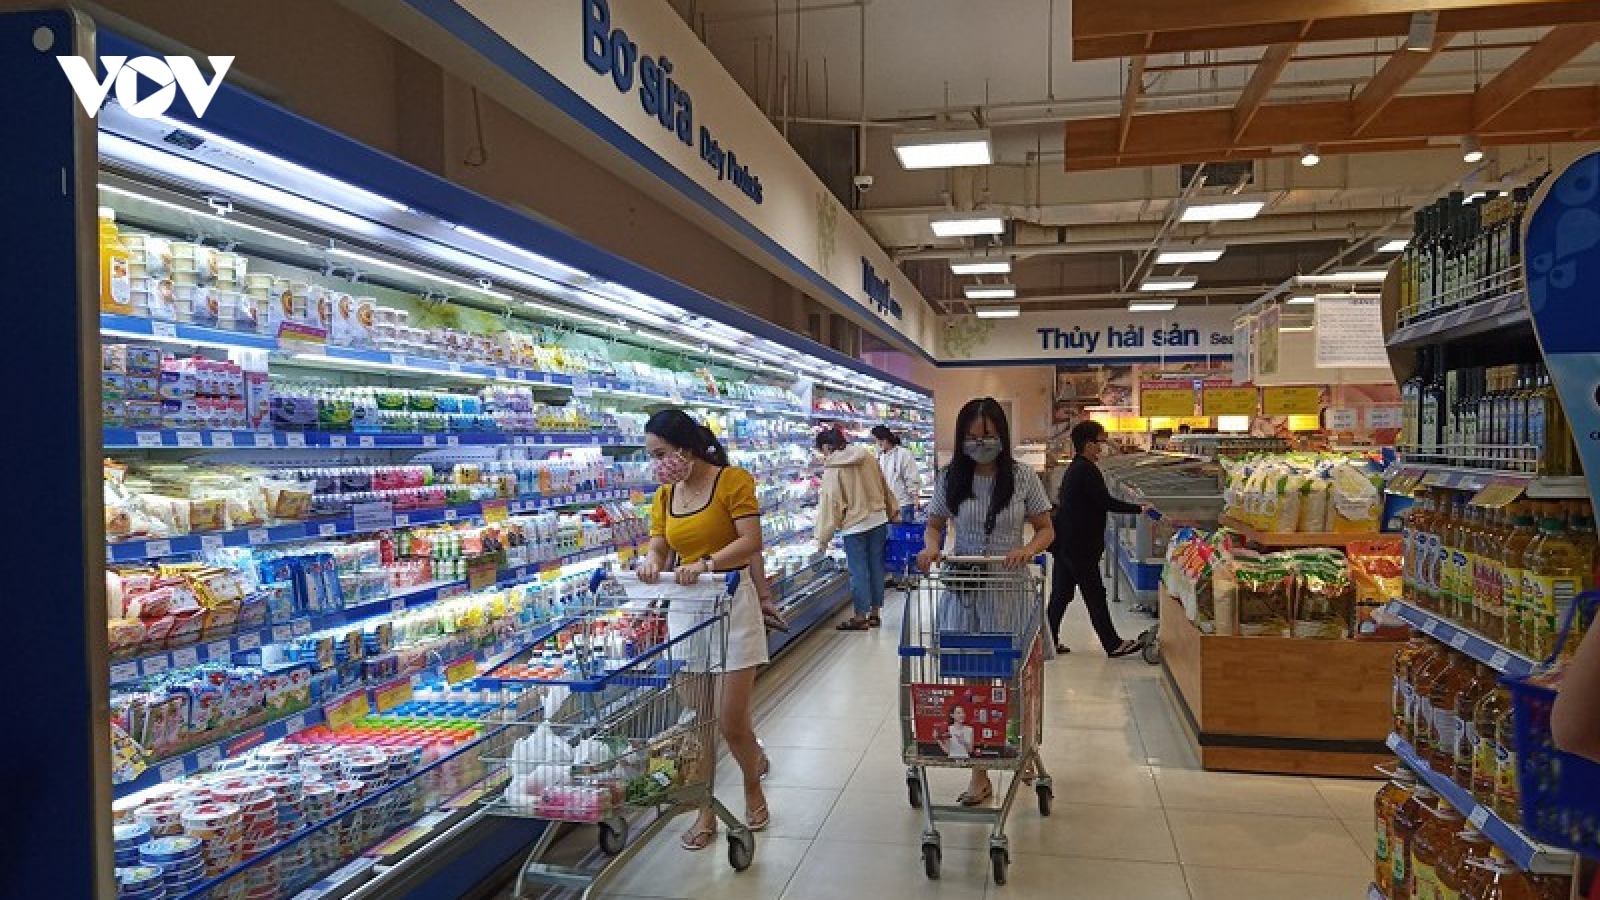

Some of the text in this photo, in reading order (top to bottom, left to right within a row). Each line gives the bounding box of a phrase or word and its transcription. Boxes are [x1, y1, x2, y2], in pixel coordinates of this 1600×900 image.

[583, 0, 693, 147] Bơ sữa
[1036, 325, 1101, 354] Thủy
[1107, 323, 1145, 349] hải
[1151, 322, 1200, 348] sản
